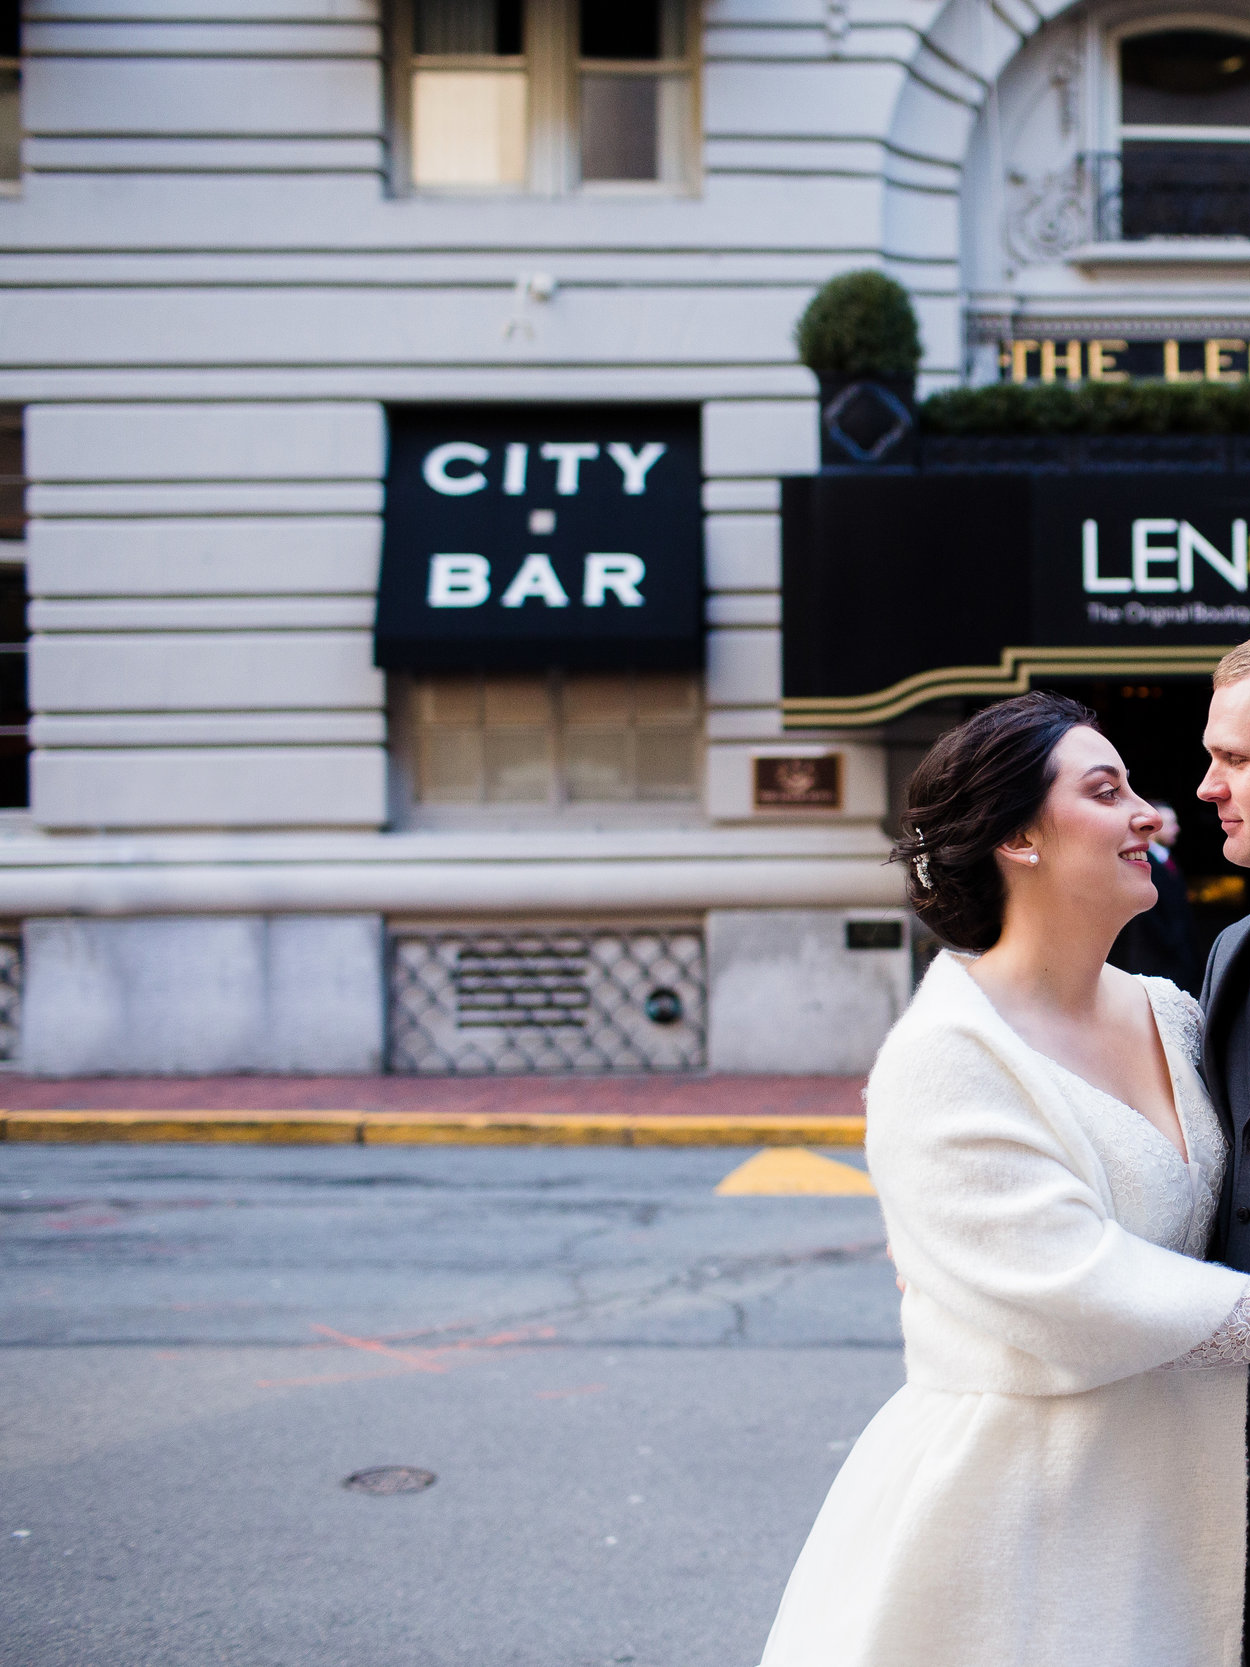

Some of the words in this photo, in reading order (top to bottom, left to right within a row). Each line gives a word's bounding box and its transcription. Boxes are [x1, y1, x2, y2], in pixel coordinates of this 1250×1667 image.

[1011, 338, 1128, 384] THE
[421, 440, 667, 496] CITY
[426, 552, 647, 608] BAR
